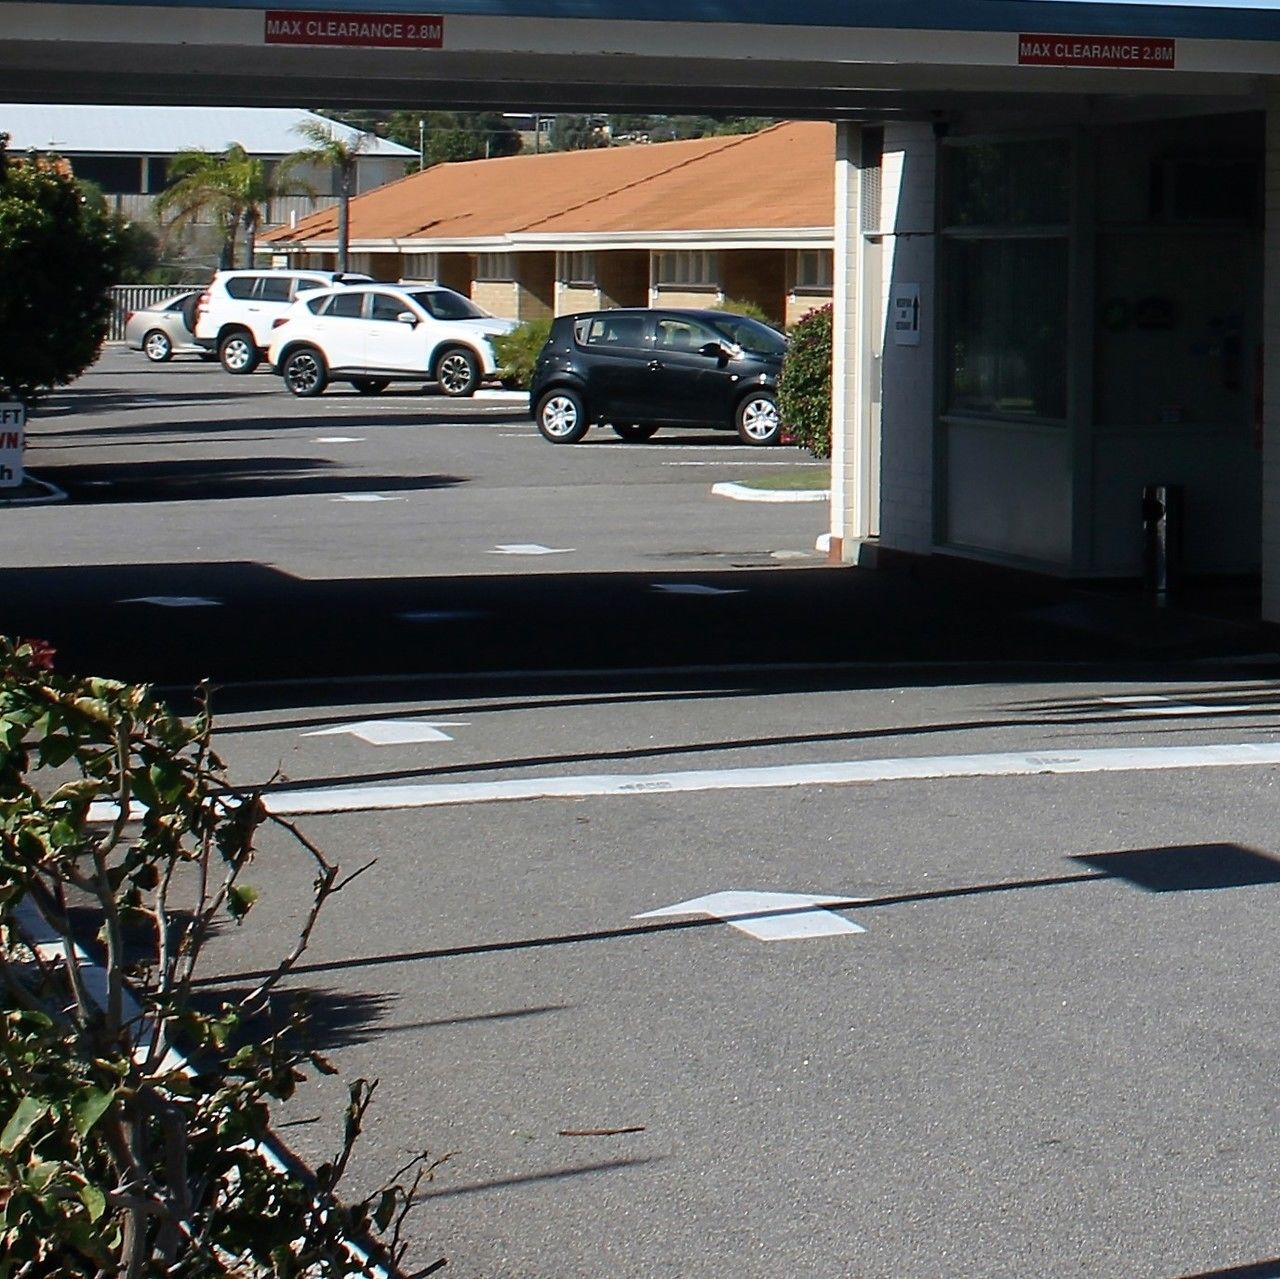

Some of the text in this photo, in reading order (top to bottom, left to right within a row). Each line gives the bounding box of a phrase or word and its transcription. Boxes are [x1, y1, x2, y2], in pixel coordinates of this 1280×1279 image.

[267, 19, 441, 40] MAX CLEARANCE 2.8M
[1020, 42, 1173, 61] MAX CLEARANCE 2.8M
